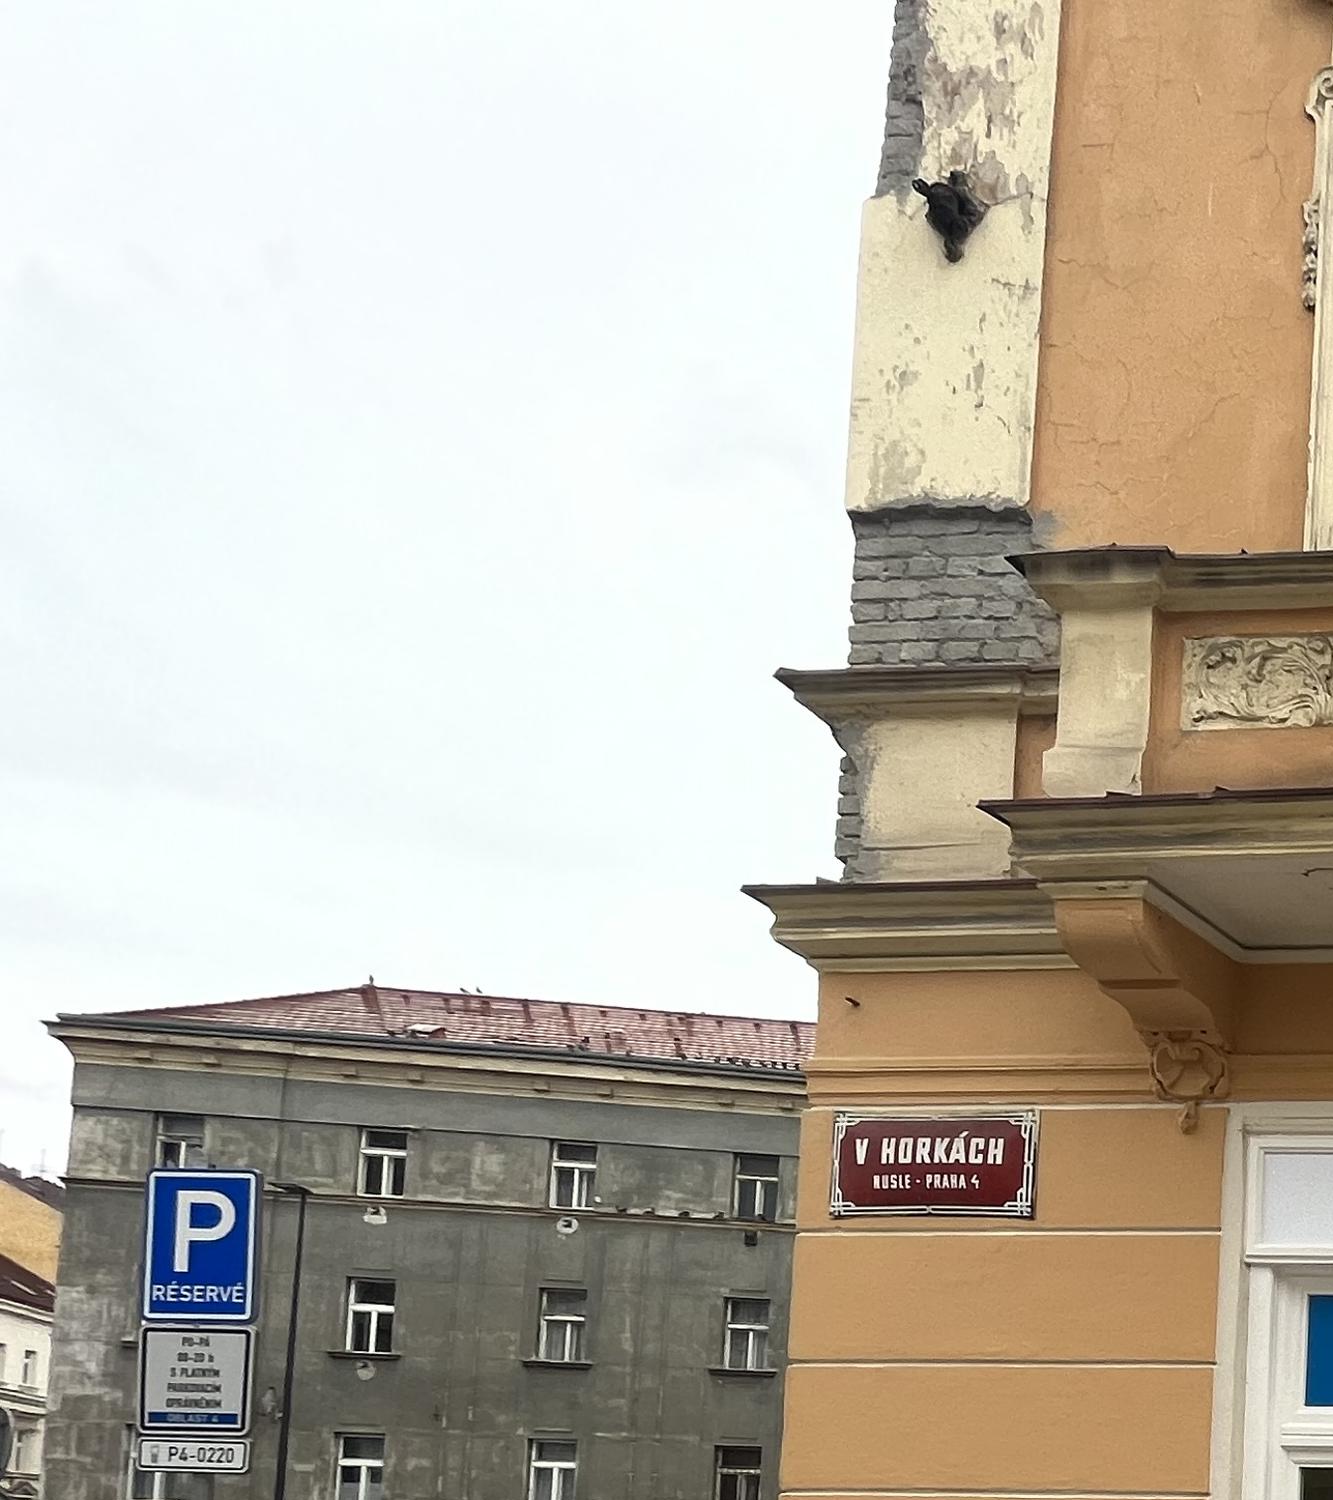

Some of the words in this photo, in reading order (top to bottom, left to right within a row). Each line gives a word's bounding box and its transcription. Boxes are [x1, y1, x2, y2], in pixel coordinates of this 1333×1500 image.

[856, 1138, 869, 1164] V
[881, 1131, 1005, 1164] HORKÁCH
[926, 1174, 966, 1189] PRAHA
[970, 1174, 980, 1189] 4
[174, 1190, 236, 1272] P
[152, 1281, 244, 1302] RÉSERVÉ
[168, 1446, 234, 1463] P4-0220
